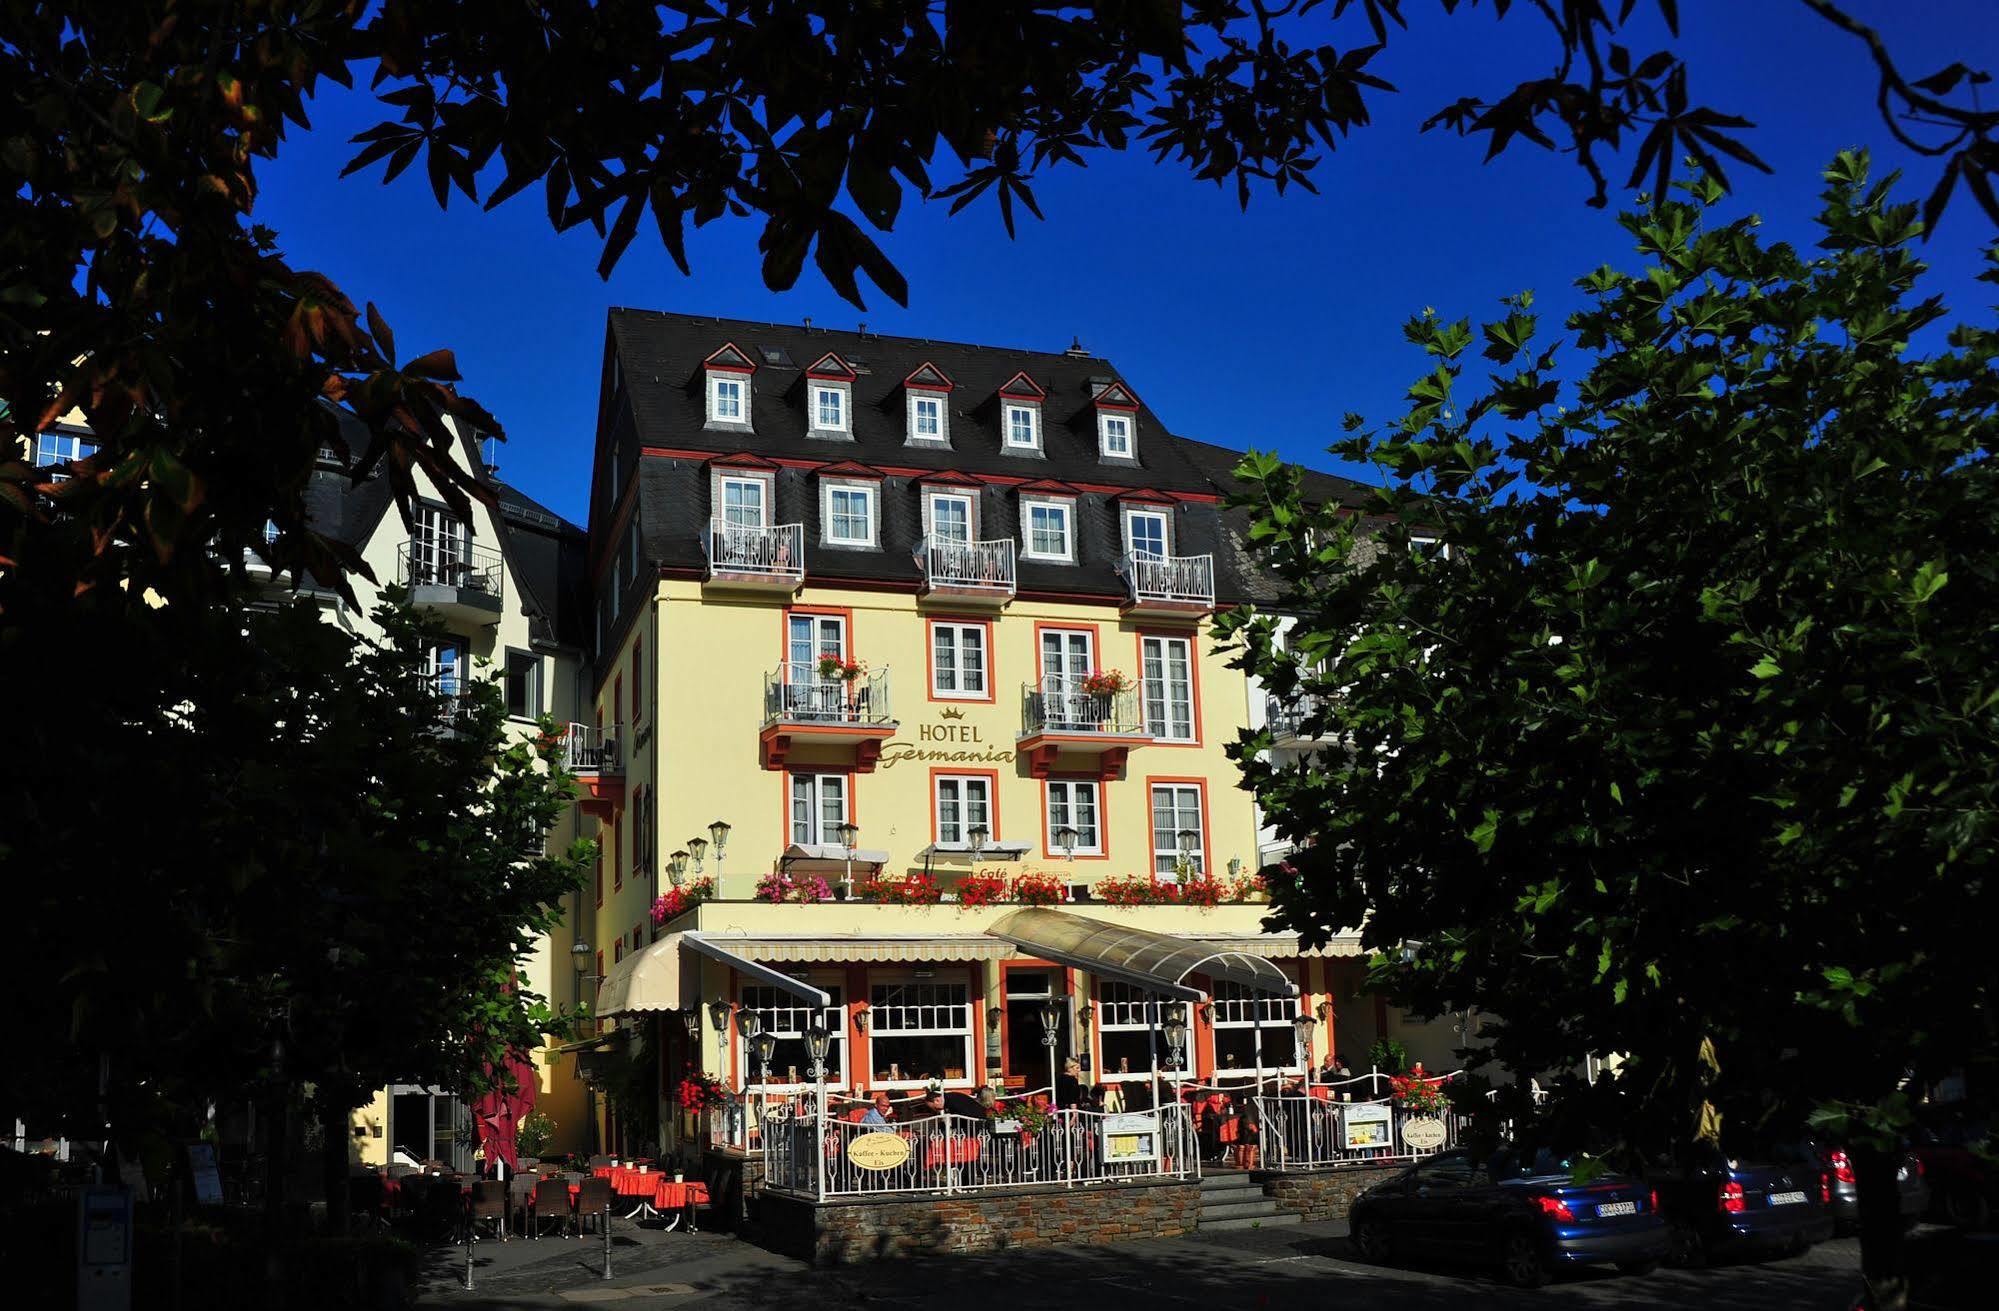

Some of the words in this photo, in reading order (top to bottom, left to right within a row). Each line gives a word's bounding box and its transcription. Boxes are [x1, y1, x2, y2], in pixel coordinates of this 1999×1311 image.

[920, 724, 983, 743] HOTEL
[877, 742, 1016, 769] Germania
[980, 867, 1007, 879] Café
